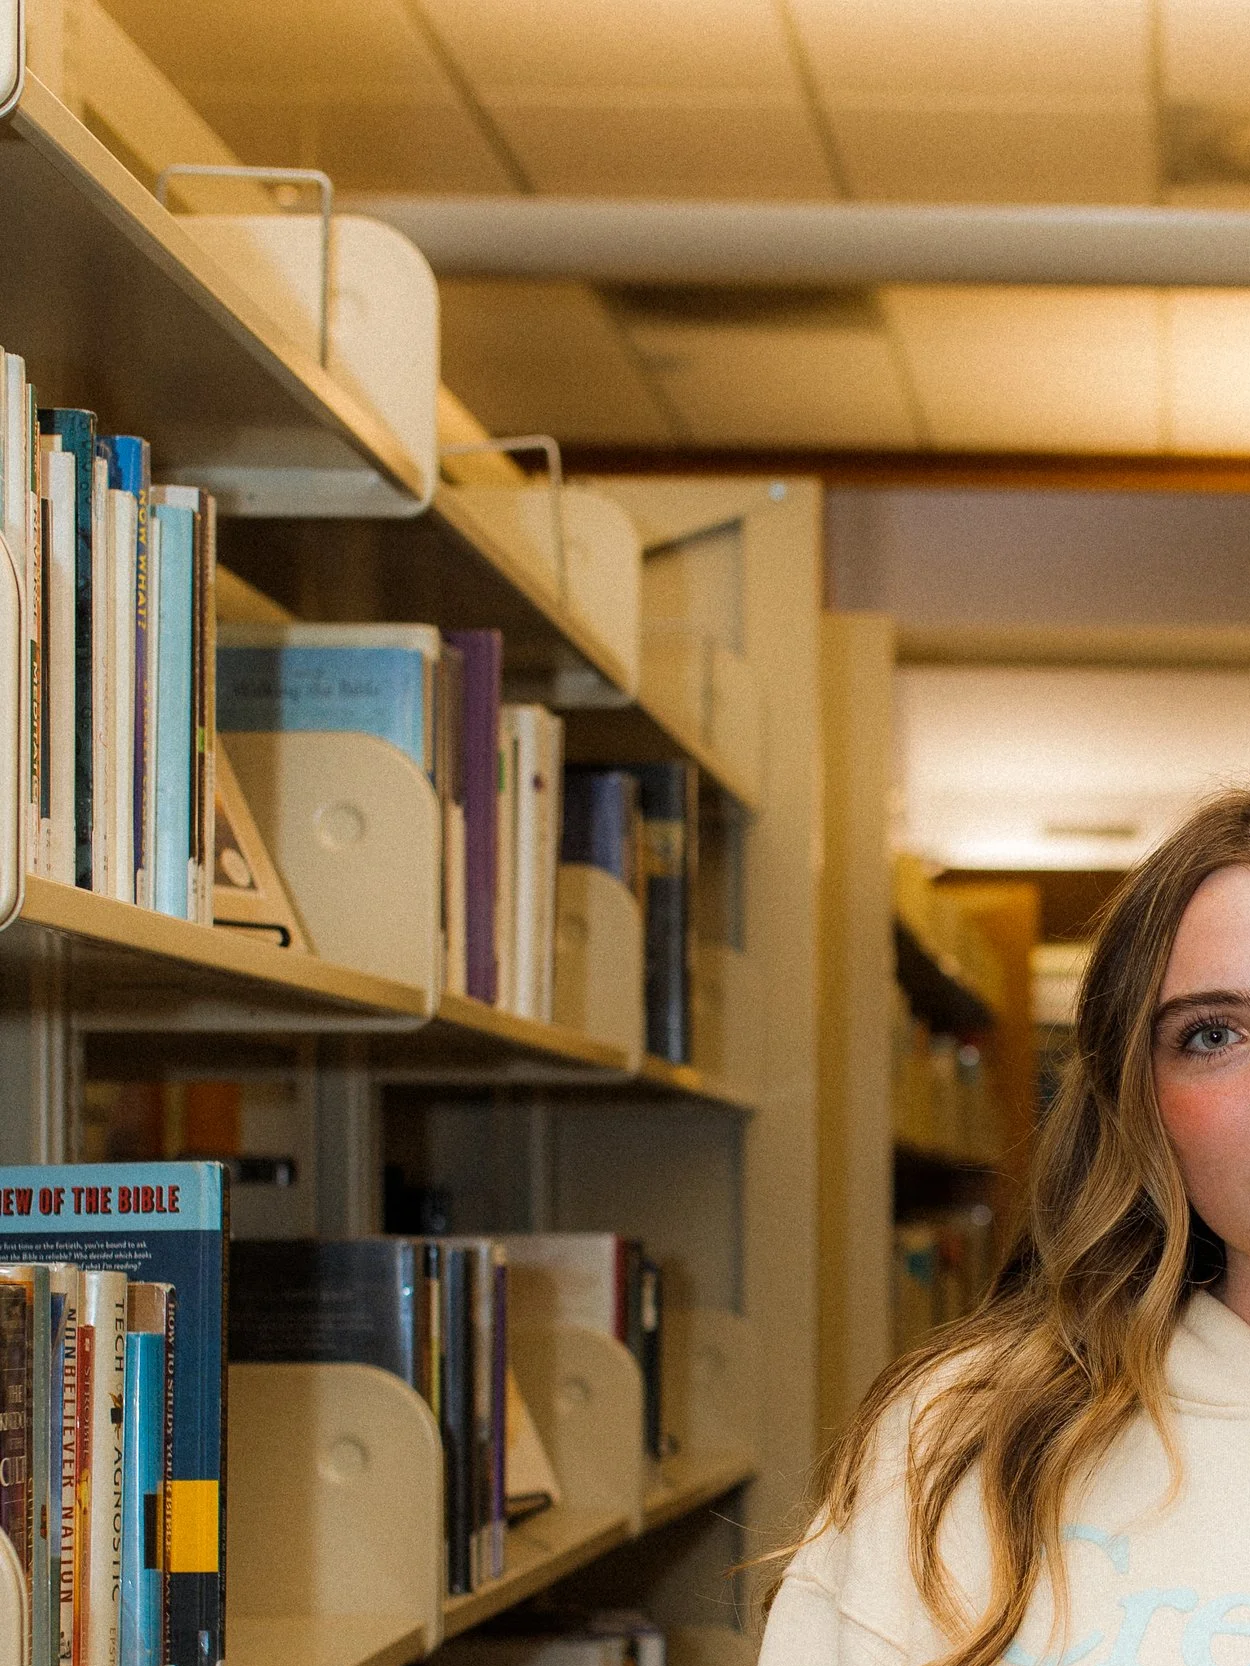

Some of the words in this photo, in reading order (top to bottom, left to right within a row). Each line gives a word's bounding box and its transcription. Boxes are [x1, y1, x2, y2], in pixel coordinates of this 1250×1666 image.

[39, 1186, 66, 1216] OF
[72, 1185, 112, 1216] THE
[118, 1185, 181, 1215] BIBLE
[114, 1297, 125, 1373] TECH
[167, 1303, 176, 1345] HOW
[167, 1351, 175, 1374] TO
[62, 1309, 77, 1489] NONBELIEVER
[83, 1365, 92, 1459] STROBEL
[166, 1378, 175, 1436] STUDY
[166, 1442, 174, 1492] YOUR
[59, 1505, 74, 1604] NATION
[111, 1446, 124, 1603] AGNOSTIC
